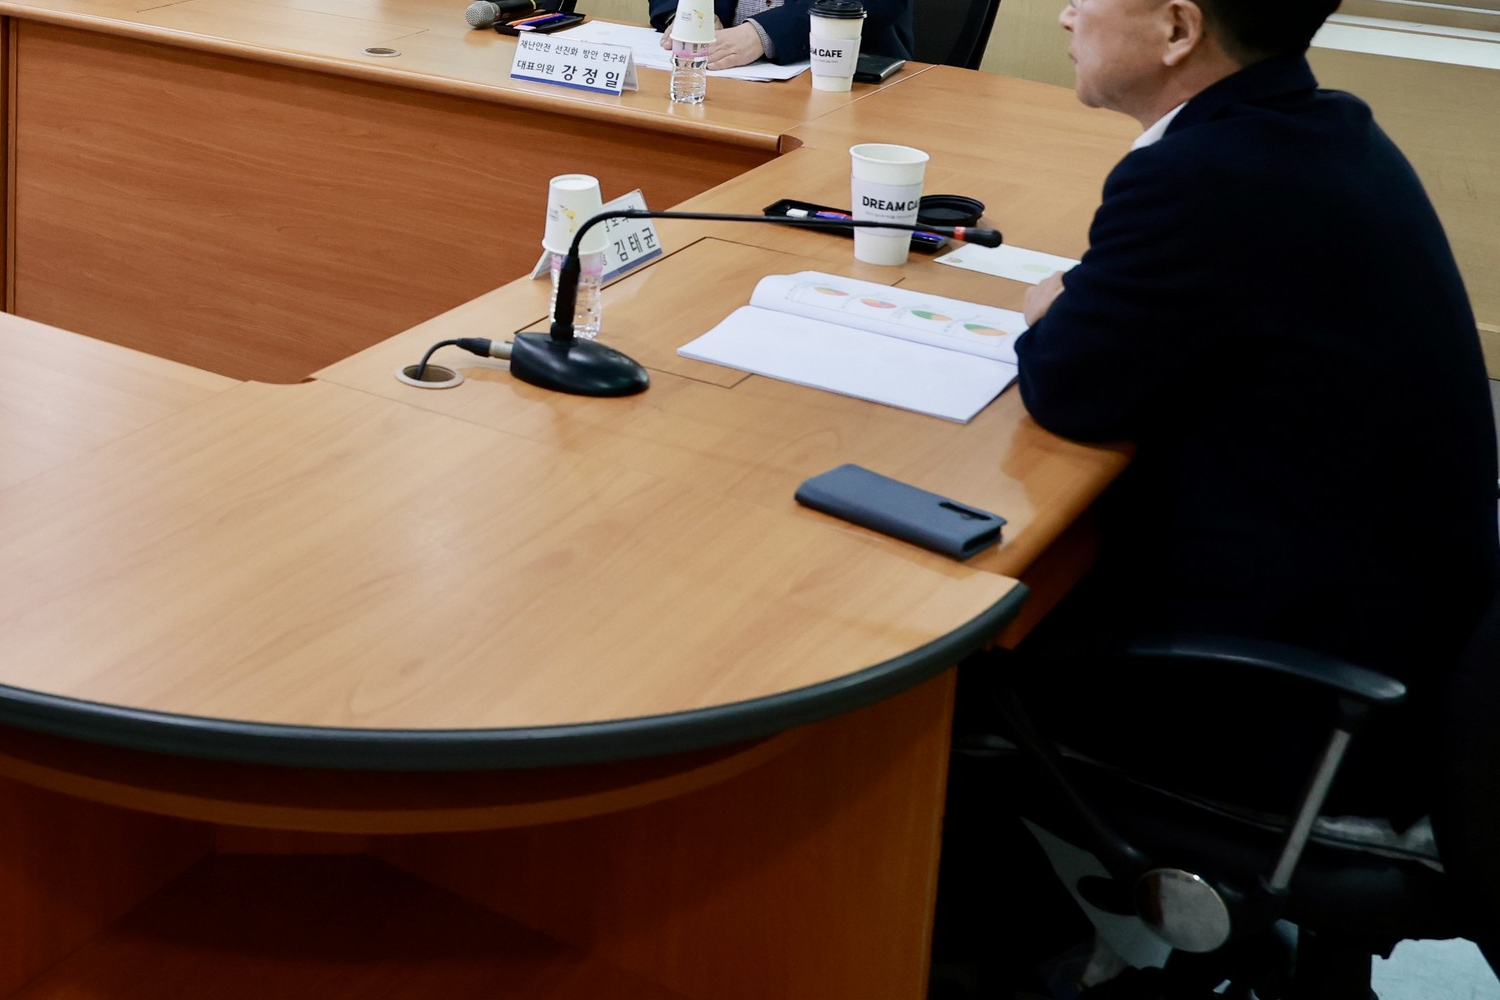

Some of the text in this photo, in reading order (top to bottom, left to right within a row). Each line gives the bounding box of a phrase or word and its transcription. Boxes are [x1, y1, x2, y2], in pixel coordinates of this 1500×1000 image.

[520, 39, 627, 64] 재난안전 선진화 방안 연구회
[818, 48, 843, 58] CAFE
[516, 60, 555, 75] 대표의원
[862, 196, 906, 212] DREAM
[614, 227, 656, 262] 김태균
